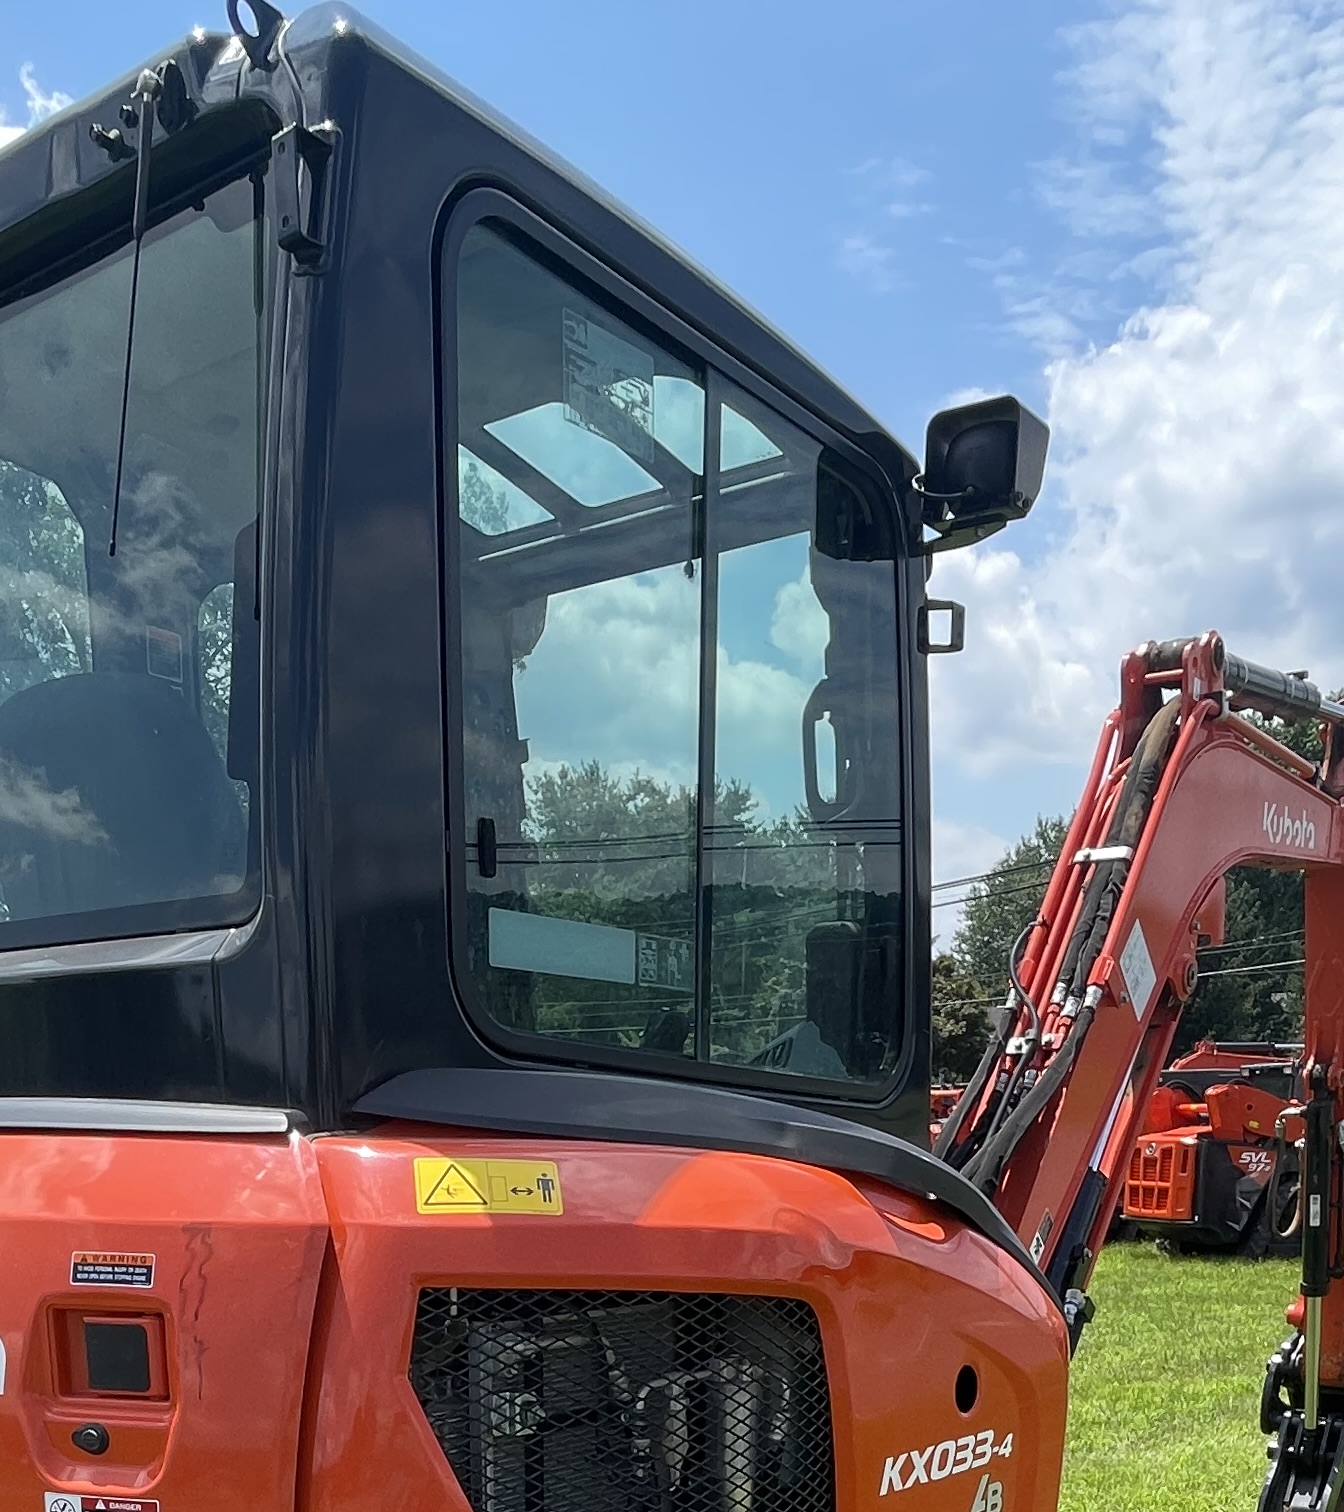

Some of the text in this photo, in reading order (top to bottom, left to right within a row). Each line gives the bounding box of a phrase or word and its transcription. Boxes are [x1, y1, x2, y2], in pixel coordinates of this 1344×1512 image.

[1263, 801, 1316, 849] Kubota
[1239, 1152, 1271, 1163] SVL
[92, 1254, 147, 1264] WARNING
[879, 1429, 1013, 1496] KX033-4
[109, 1502, 142, 1511] DANGER
